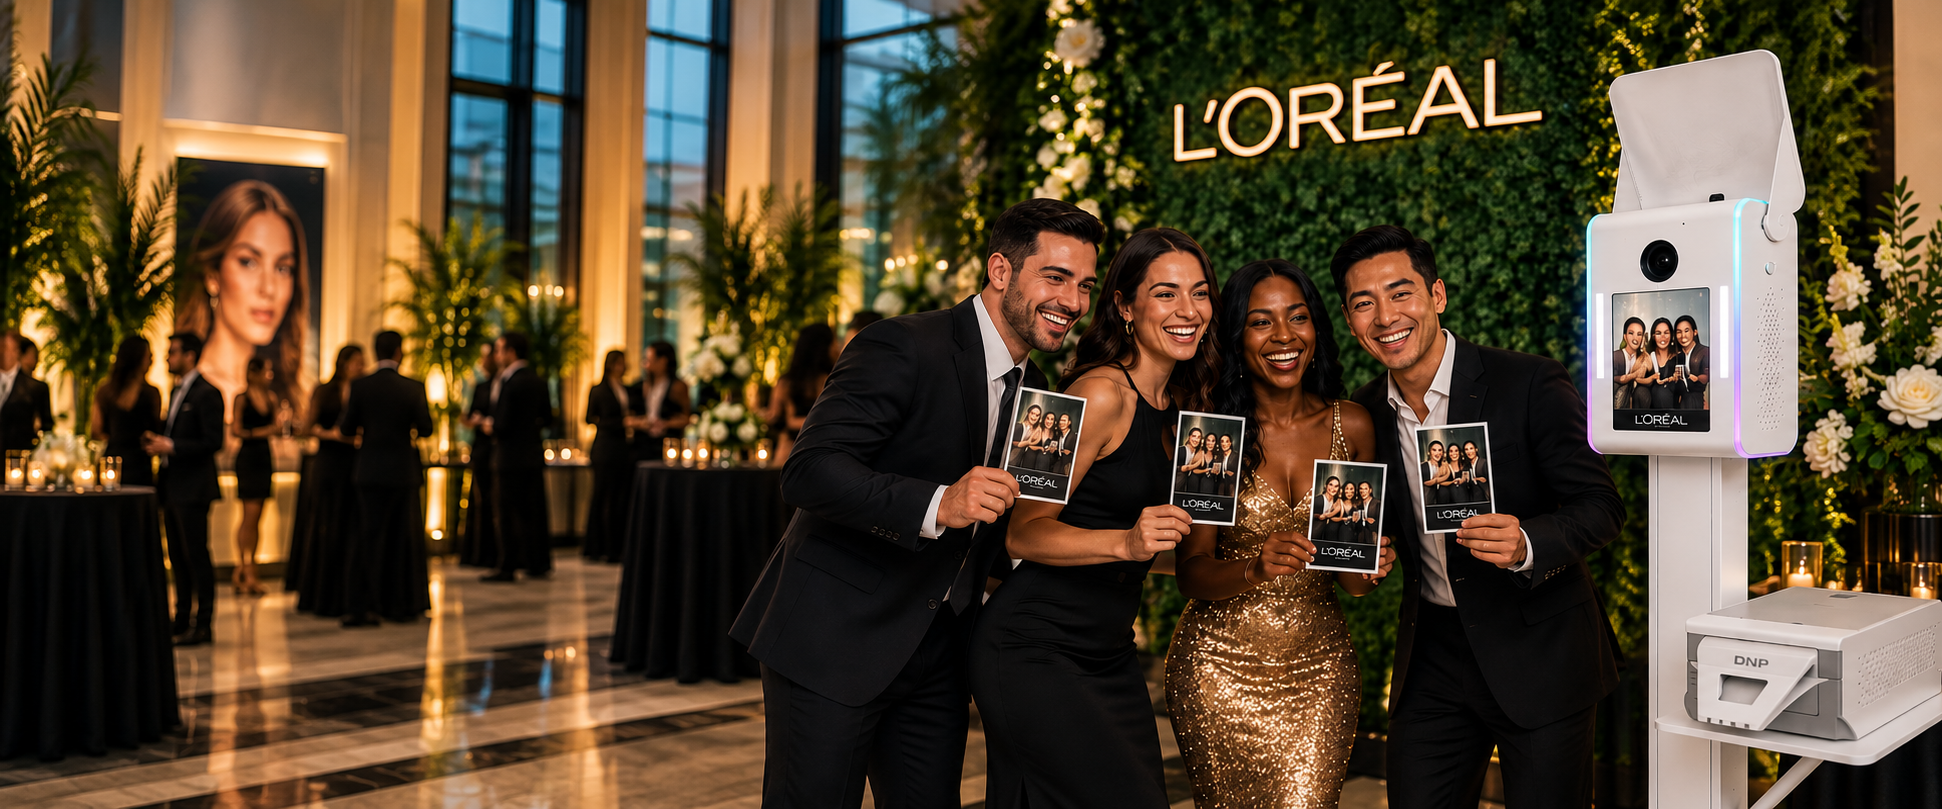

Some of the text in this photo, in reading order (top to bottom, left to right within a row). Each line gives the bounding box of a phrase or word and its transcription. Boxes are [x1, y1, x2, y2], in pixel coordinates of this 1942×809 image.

[1174, 58, 1543, 162] L'ORÉAL
[1635, 413, 1688, 426] L'ORÉAL
[1015, 474, 1058, 489] L'ORÉAL
[1321, 546, 1366, 559] L'ORÉAL
[1734, 655, 1769, 668] DNP
